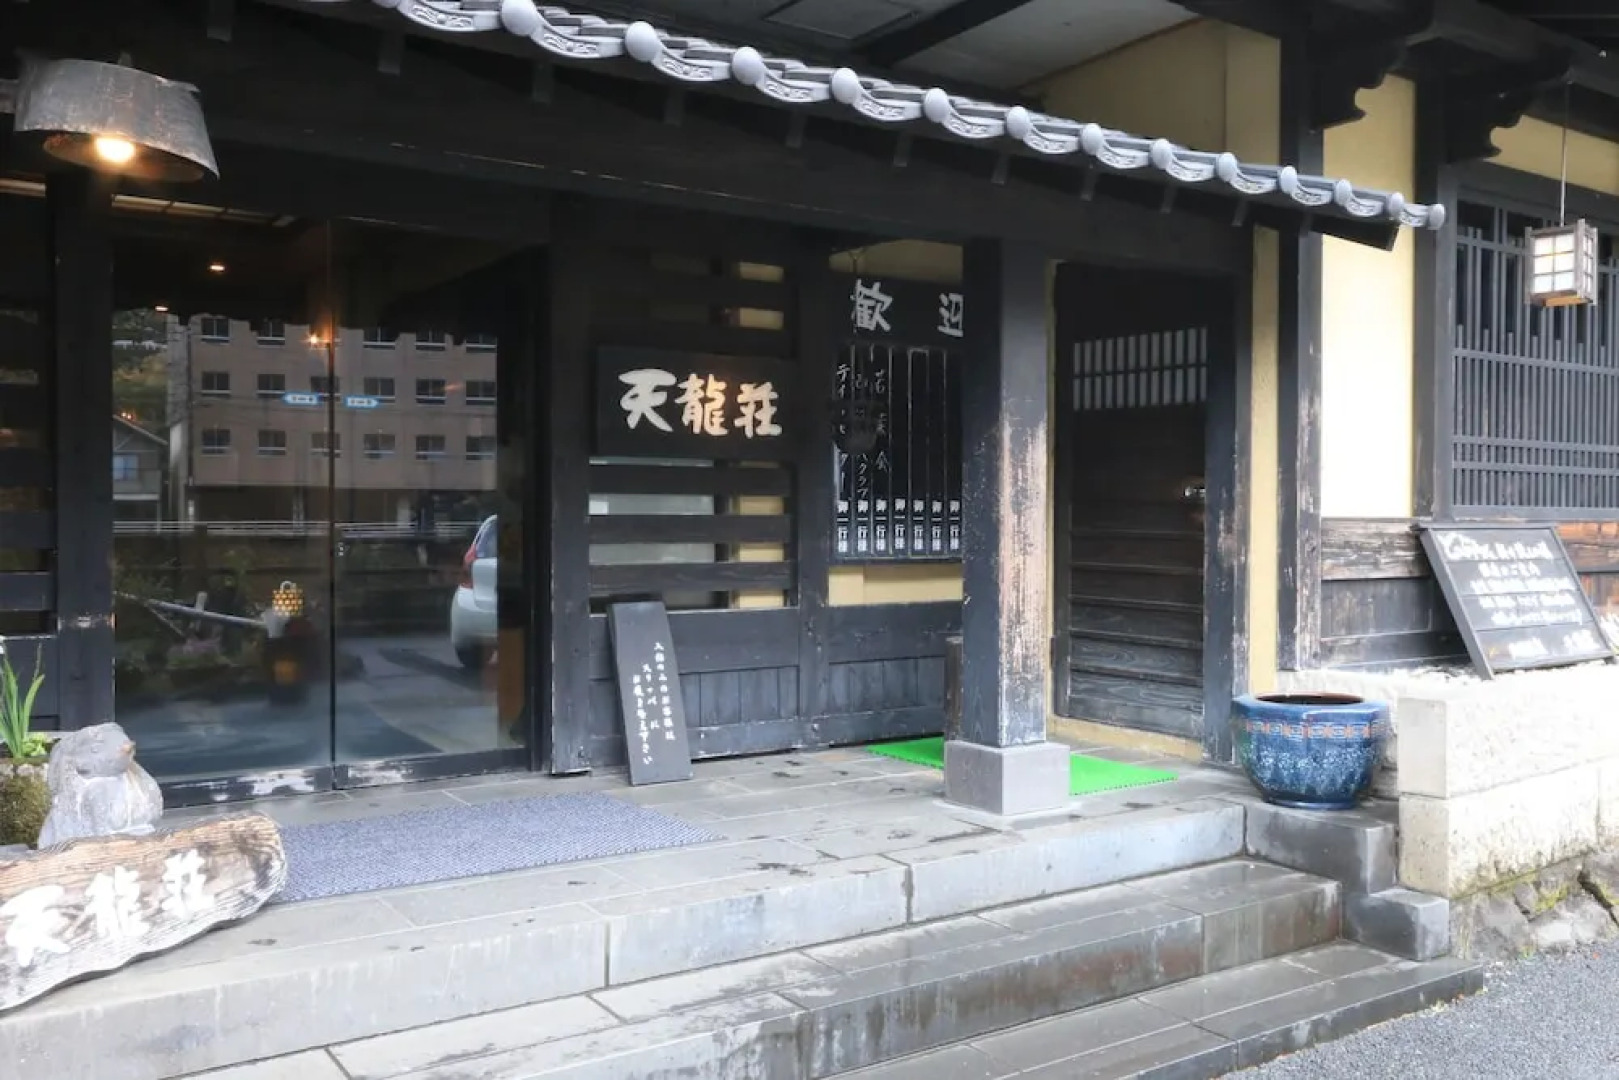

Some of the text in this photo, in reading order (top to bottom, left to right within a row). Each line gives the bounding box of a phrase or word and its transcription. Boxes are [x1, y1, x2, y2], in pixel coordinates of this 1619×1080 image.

[618, 368, 783, 439] 天龍荘
[0, 849, 216, 968] 天龍荘
